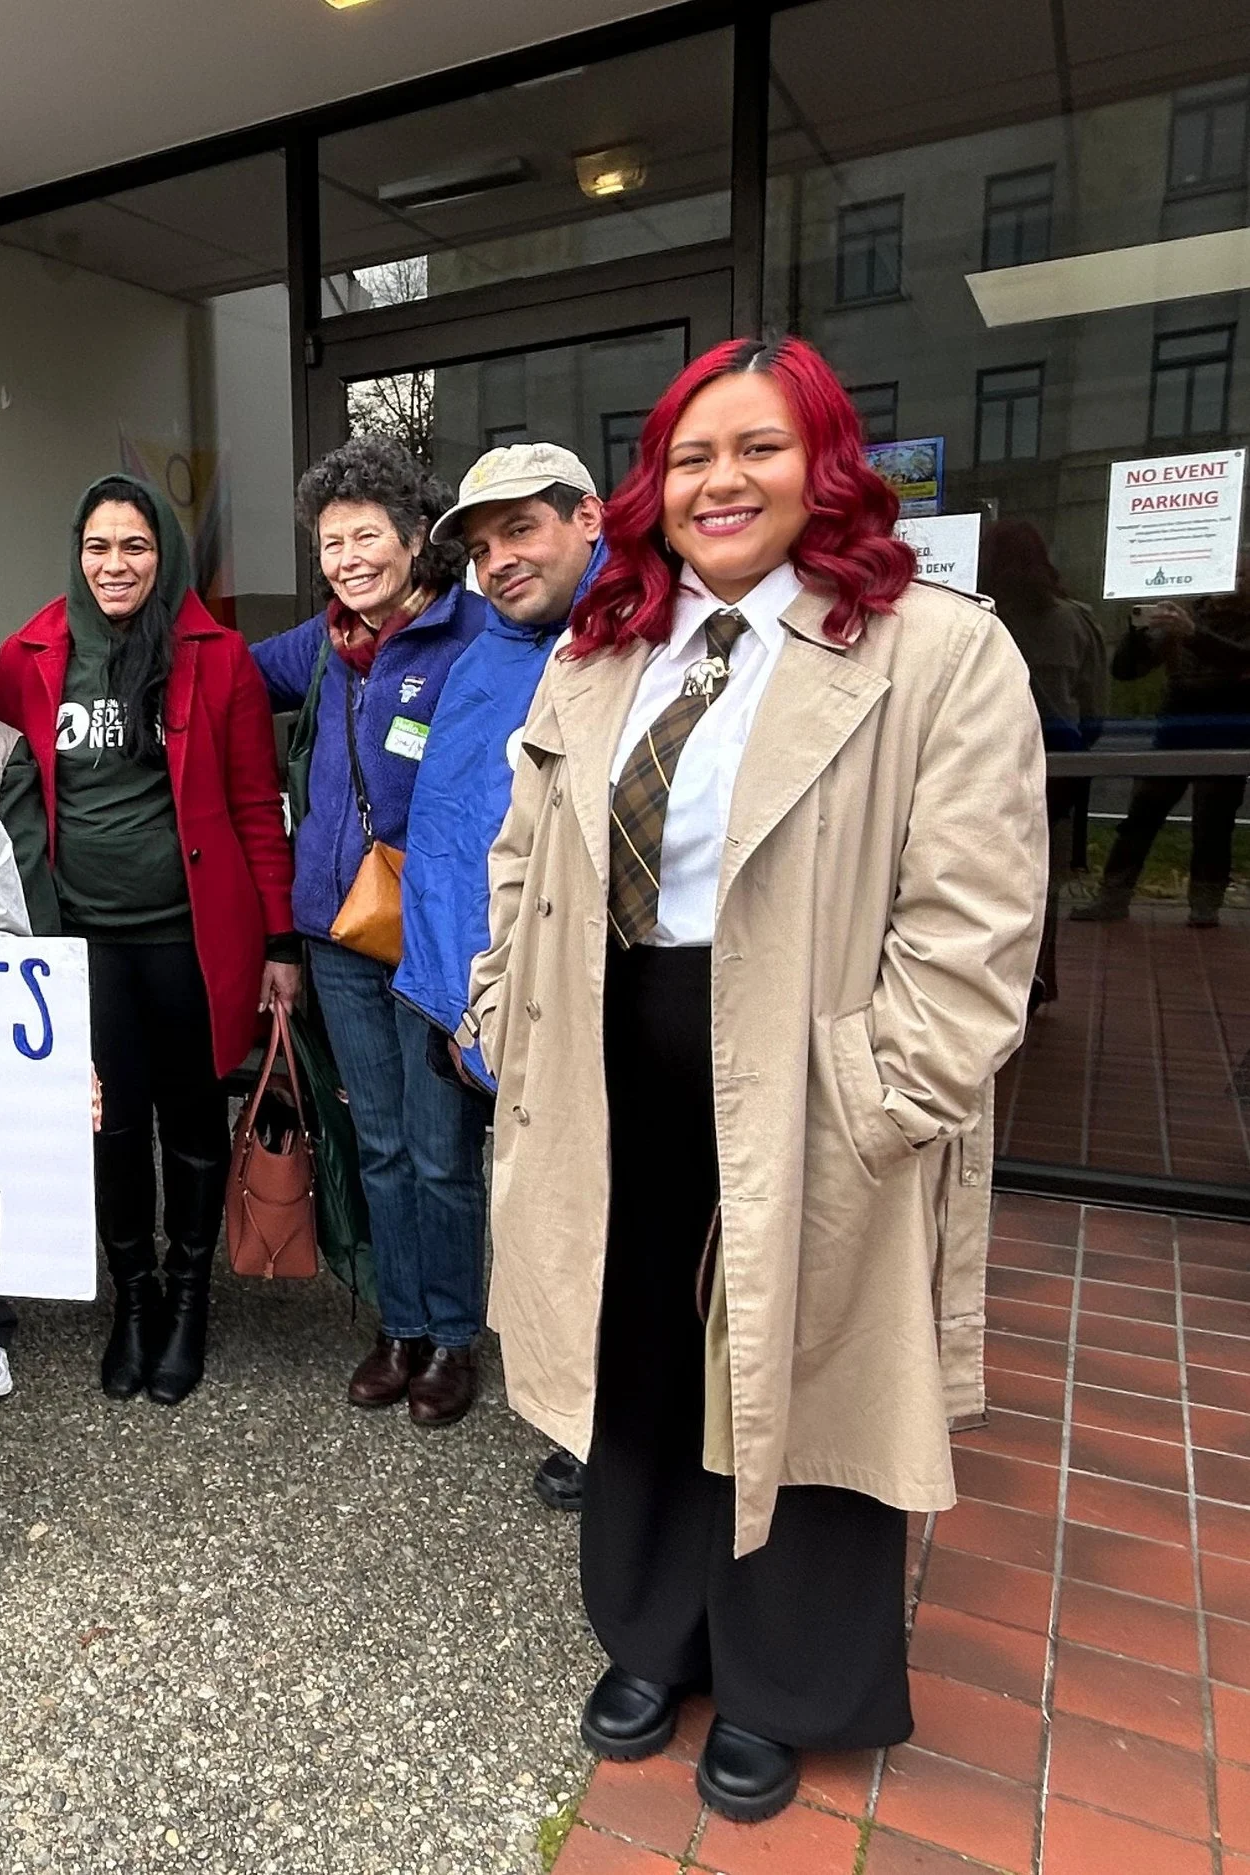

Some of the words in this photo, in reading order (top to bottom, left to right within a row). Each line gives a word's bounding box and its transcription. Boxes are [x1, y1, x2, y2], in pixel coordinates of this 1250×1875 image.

[1126, 469, 1156, 484] NO
[1163, 461, 1229, 481] EVENT
[1131, 491, 1219, 511] PARKING
[926, 562, 955, 575] DENY
